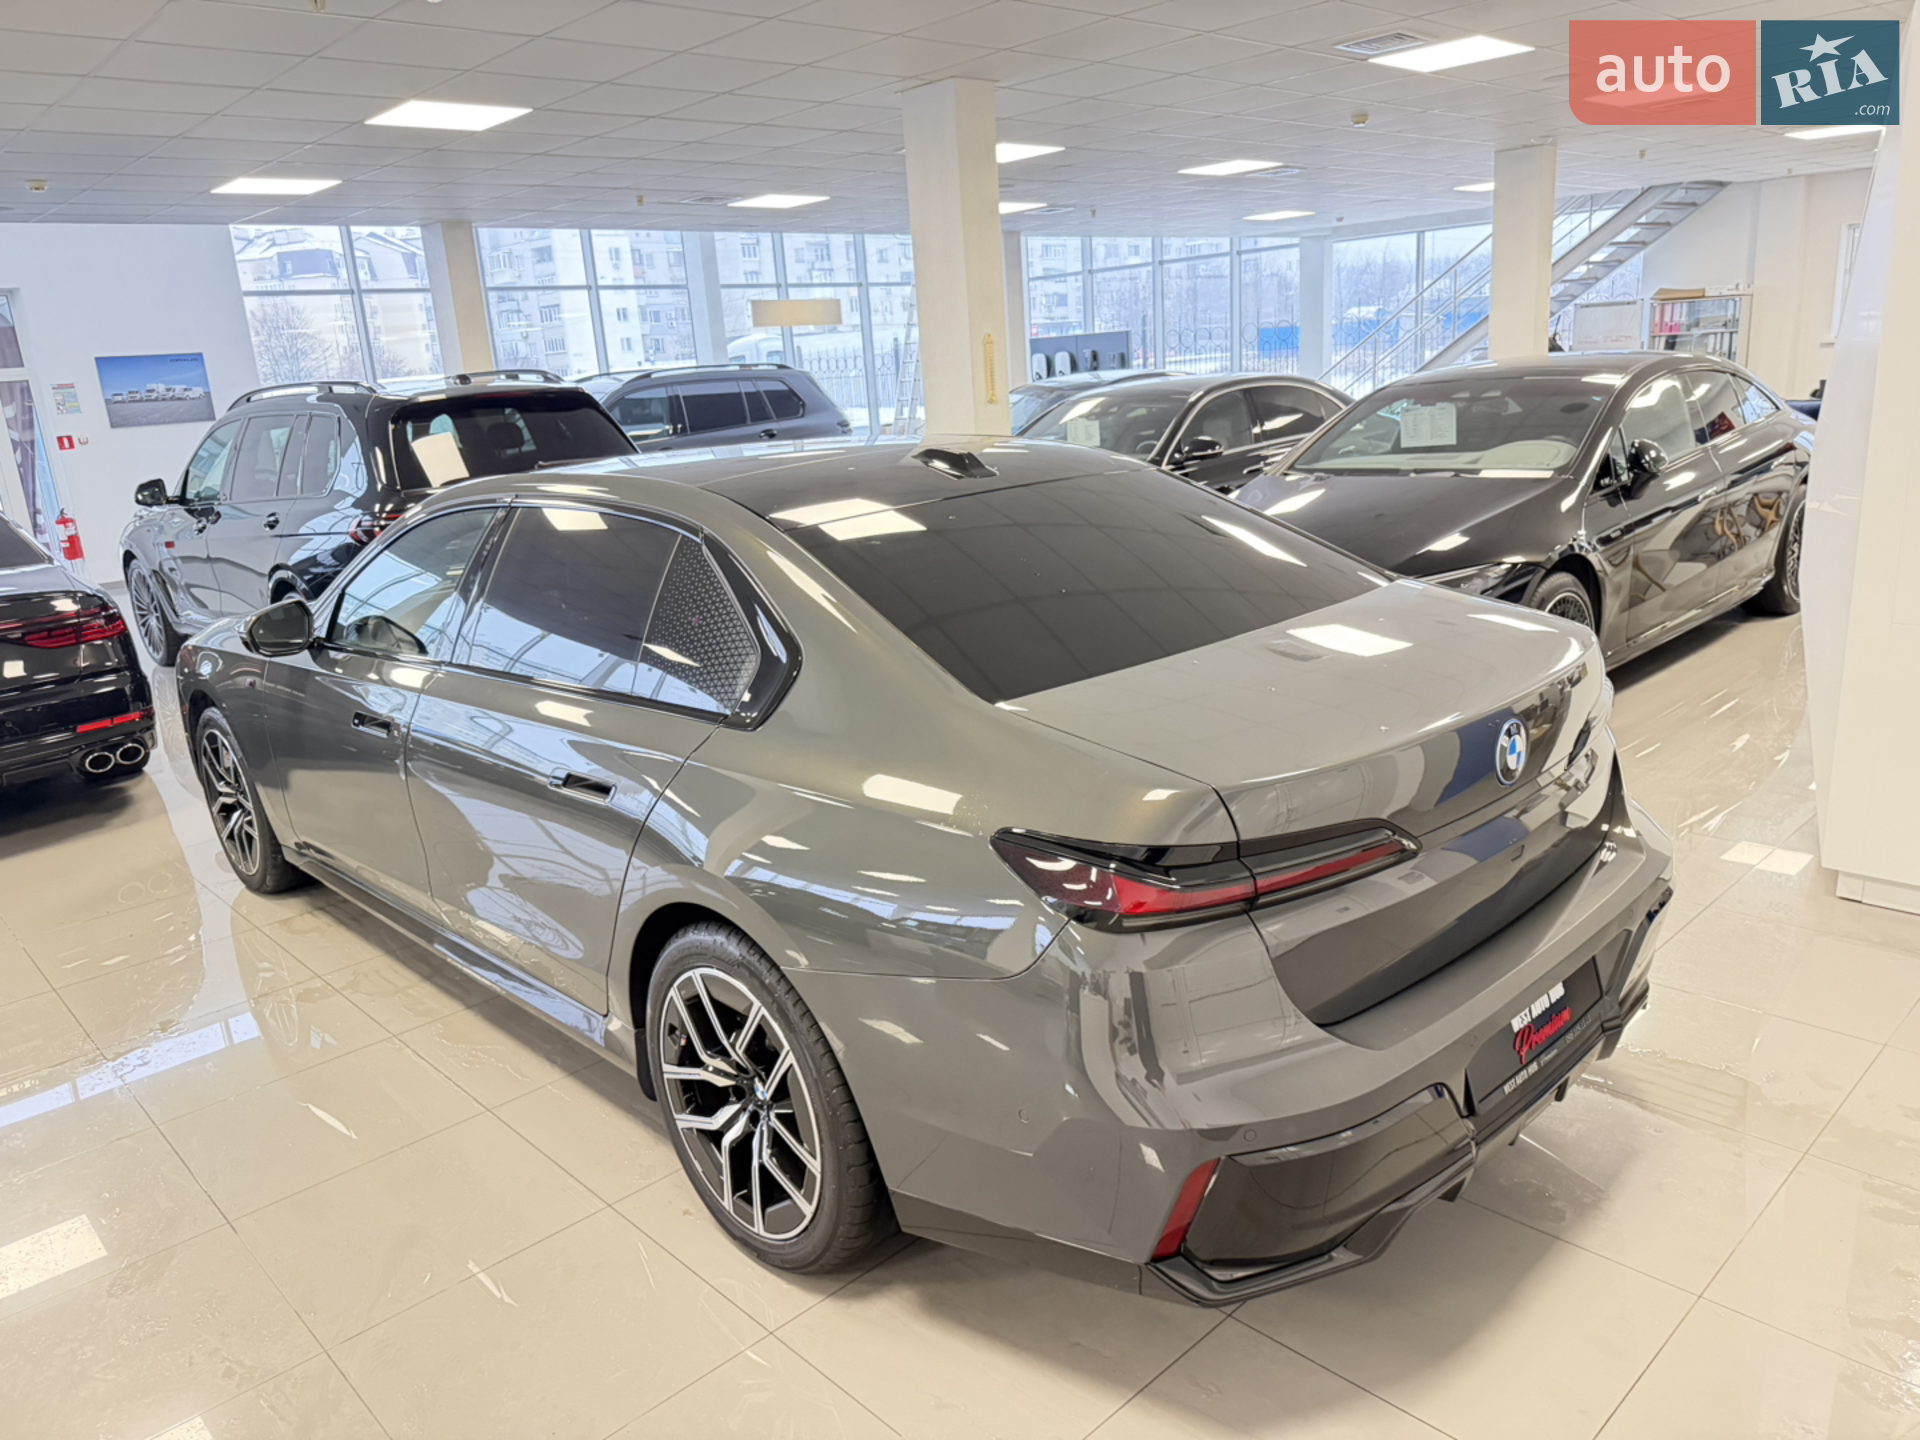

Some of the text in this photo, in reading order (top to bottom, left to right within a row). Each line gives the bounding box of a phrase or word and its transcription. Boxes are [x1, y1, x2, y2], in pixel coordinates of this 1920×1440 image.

[1510, 981, 1565, 1033] WEST AUTO HUB
[1513, 1007, 1572, 1064] Premium
[1503, 1079, 1517, 1095] WEST
[1515, 1068, 1529, 1086] AUTO
